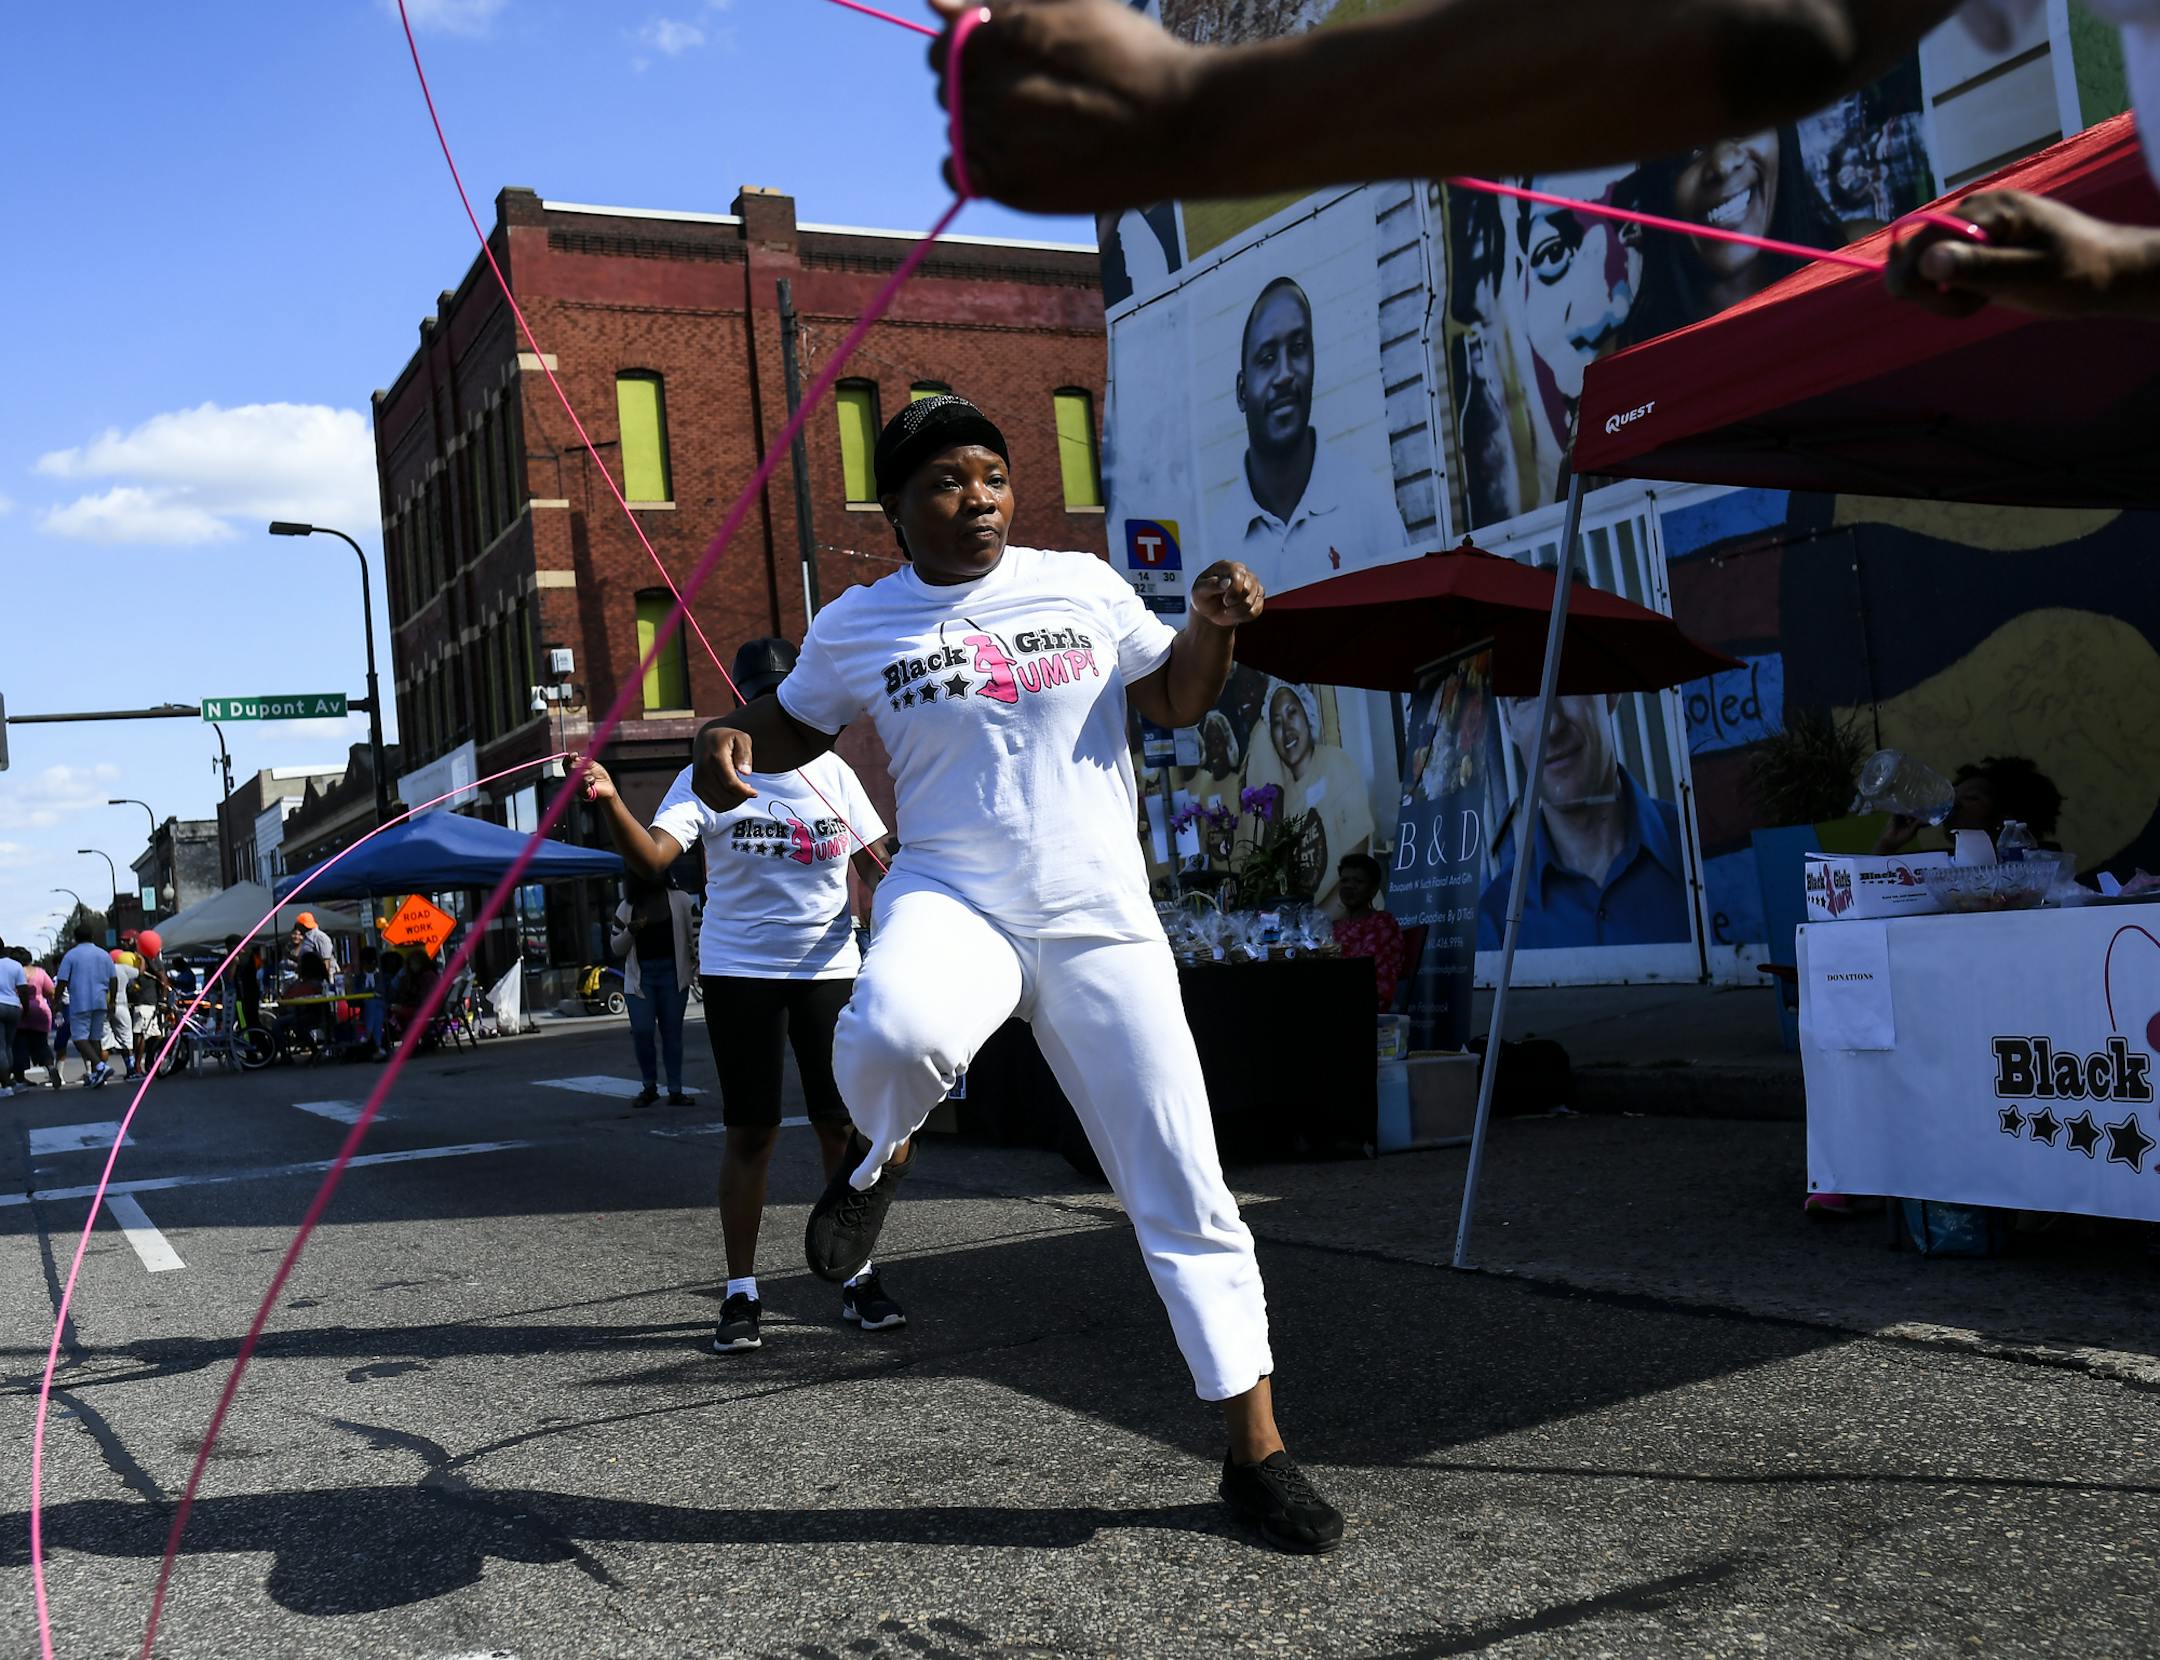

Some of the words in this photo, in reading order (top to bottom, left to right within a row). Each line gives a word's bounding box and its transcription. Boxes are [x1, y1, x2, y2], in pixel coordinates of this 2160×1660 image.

[1605, 401, 1656, 434] QUEST
[1137, 536, 1161, 561] T
[1138, 572, 1150, 581] 14
[1163, 572, 1175, 582] 30
[1134, 583, 1146, 593] 32
[881, 645, 969, 695] Black
[1013, 627, 1094, 655] Girls
[207, 702, 221, 717] N
[230, 700, 305, 718] Dupont
[315, 699, 341, 713] Av
[733, 819, 790, 839] Black
[1394, 822, 1417, 871] B
[1427, 814, 1448, 866] &
[1458, 809, 1480, 862] D
[403, 910, 431, 921] ROAD
[405, 923, 433, 935] WORK
[1827, 973, 1874, 981] DONATIONS
[1992, 1036, 2153, 1102] Black
